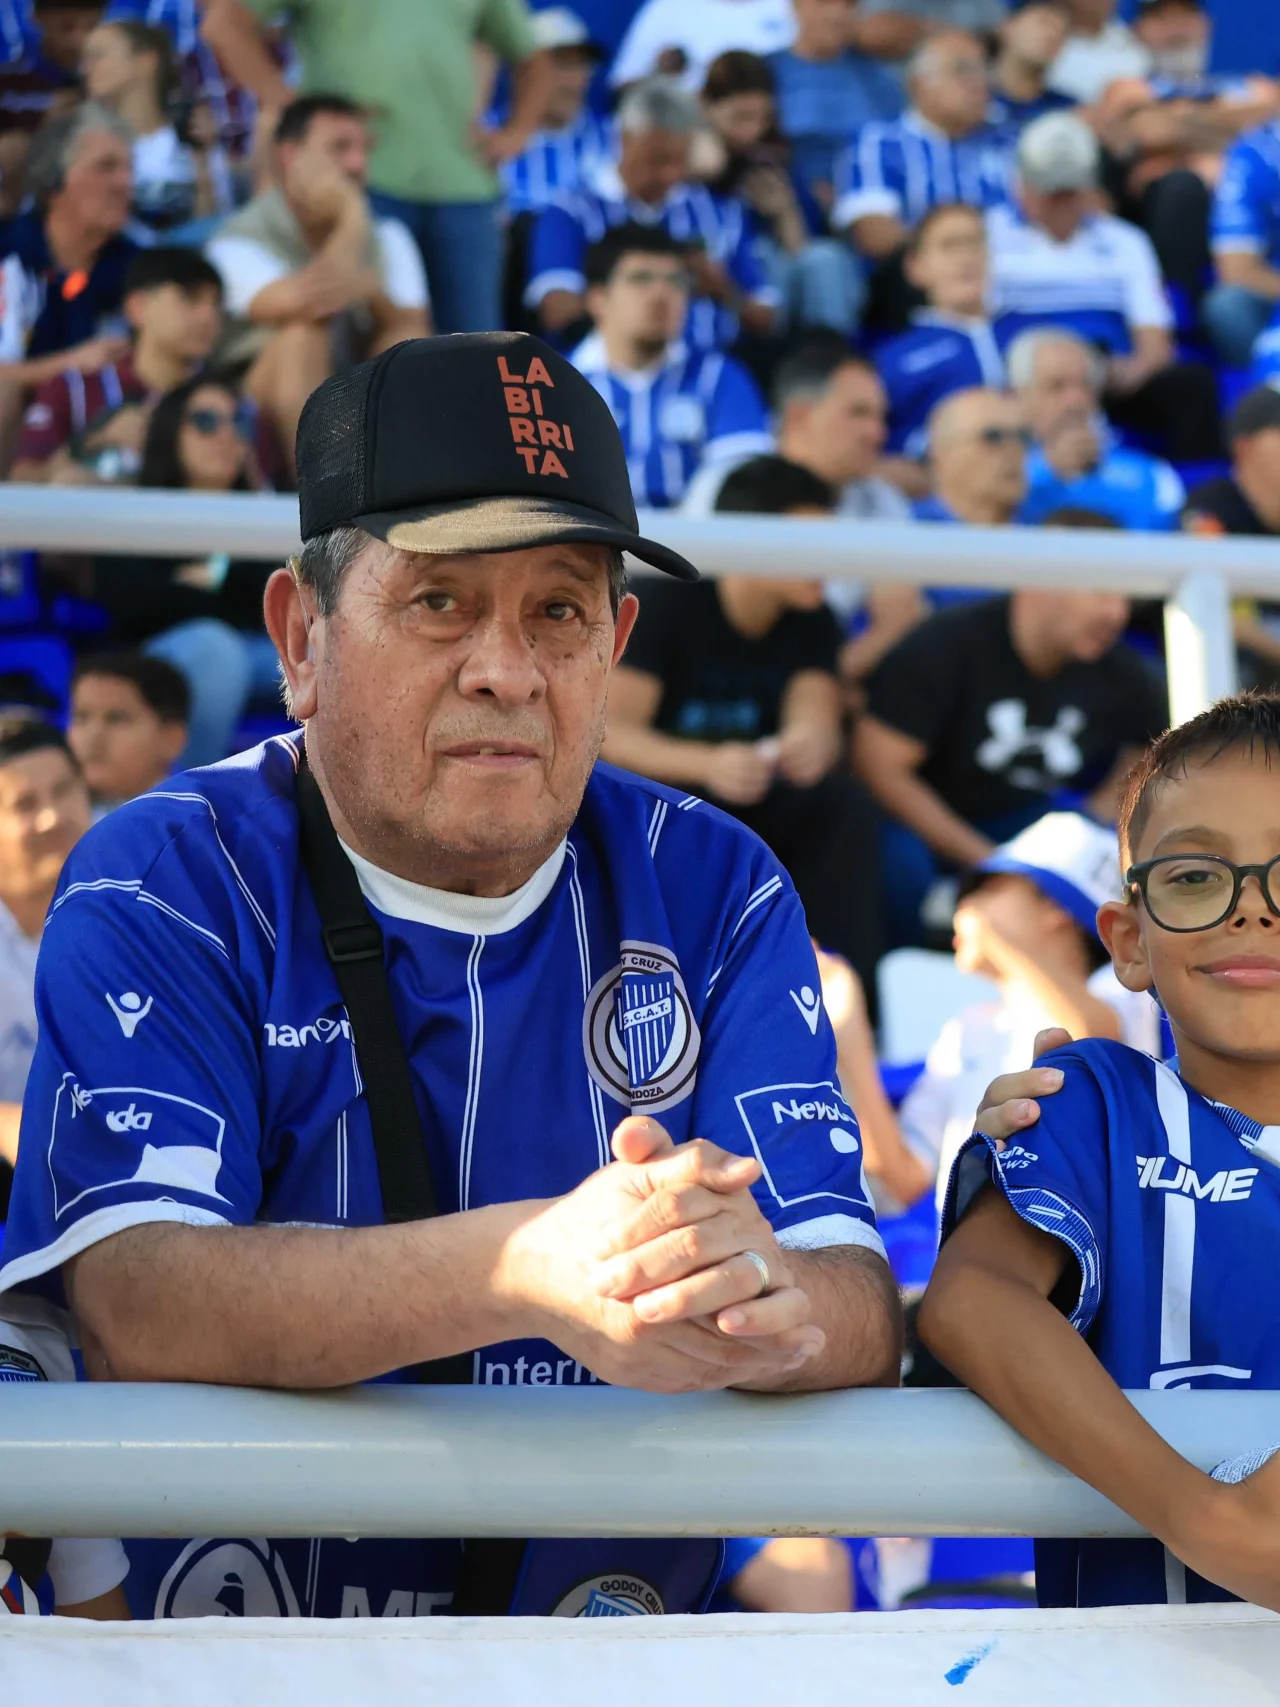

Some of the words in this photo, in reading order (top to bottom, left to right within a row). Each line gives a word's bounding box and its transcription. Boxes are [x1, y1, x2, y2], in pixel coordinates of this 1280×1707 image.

[497, 356, 554, 387] LA
[504, 387, 543, 415] BI
[509, 417, 574, 451] RRI
[516, 446, 569, 478] TA
[631, 957, 662, 971] CRUZ
[630, 1086, 664, 1099] NDOZA
[601, 1580, 645, 1596] GODOY
